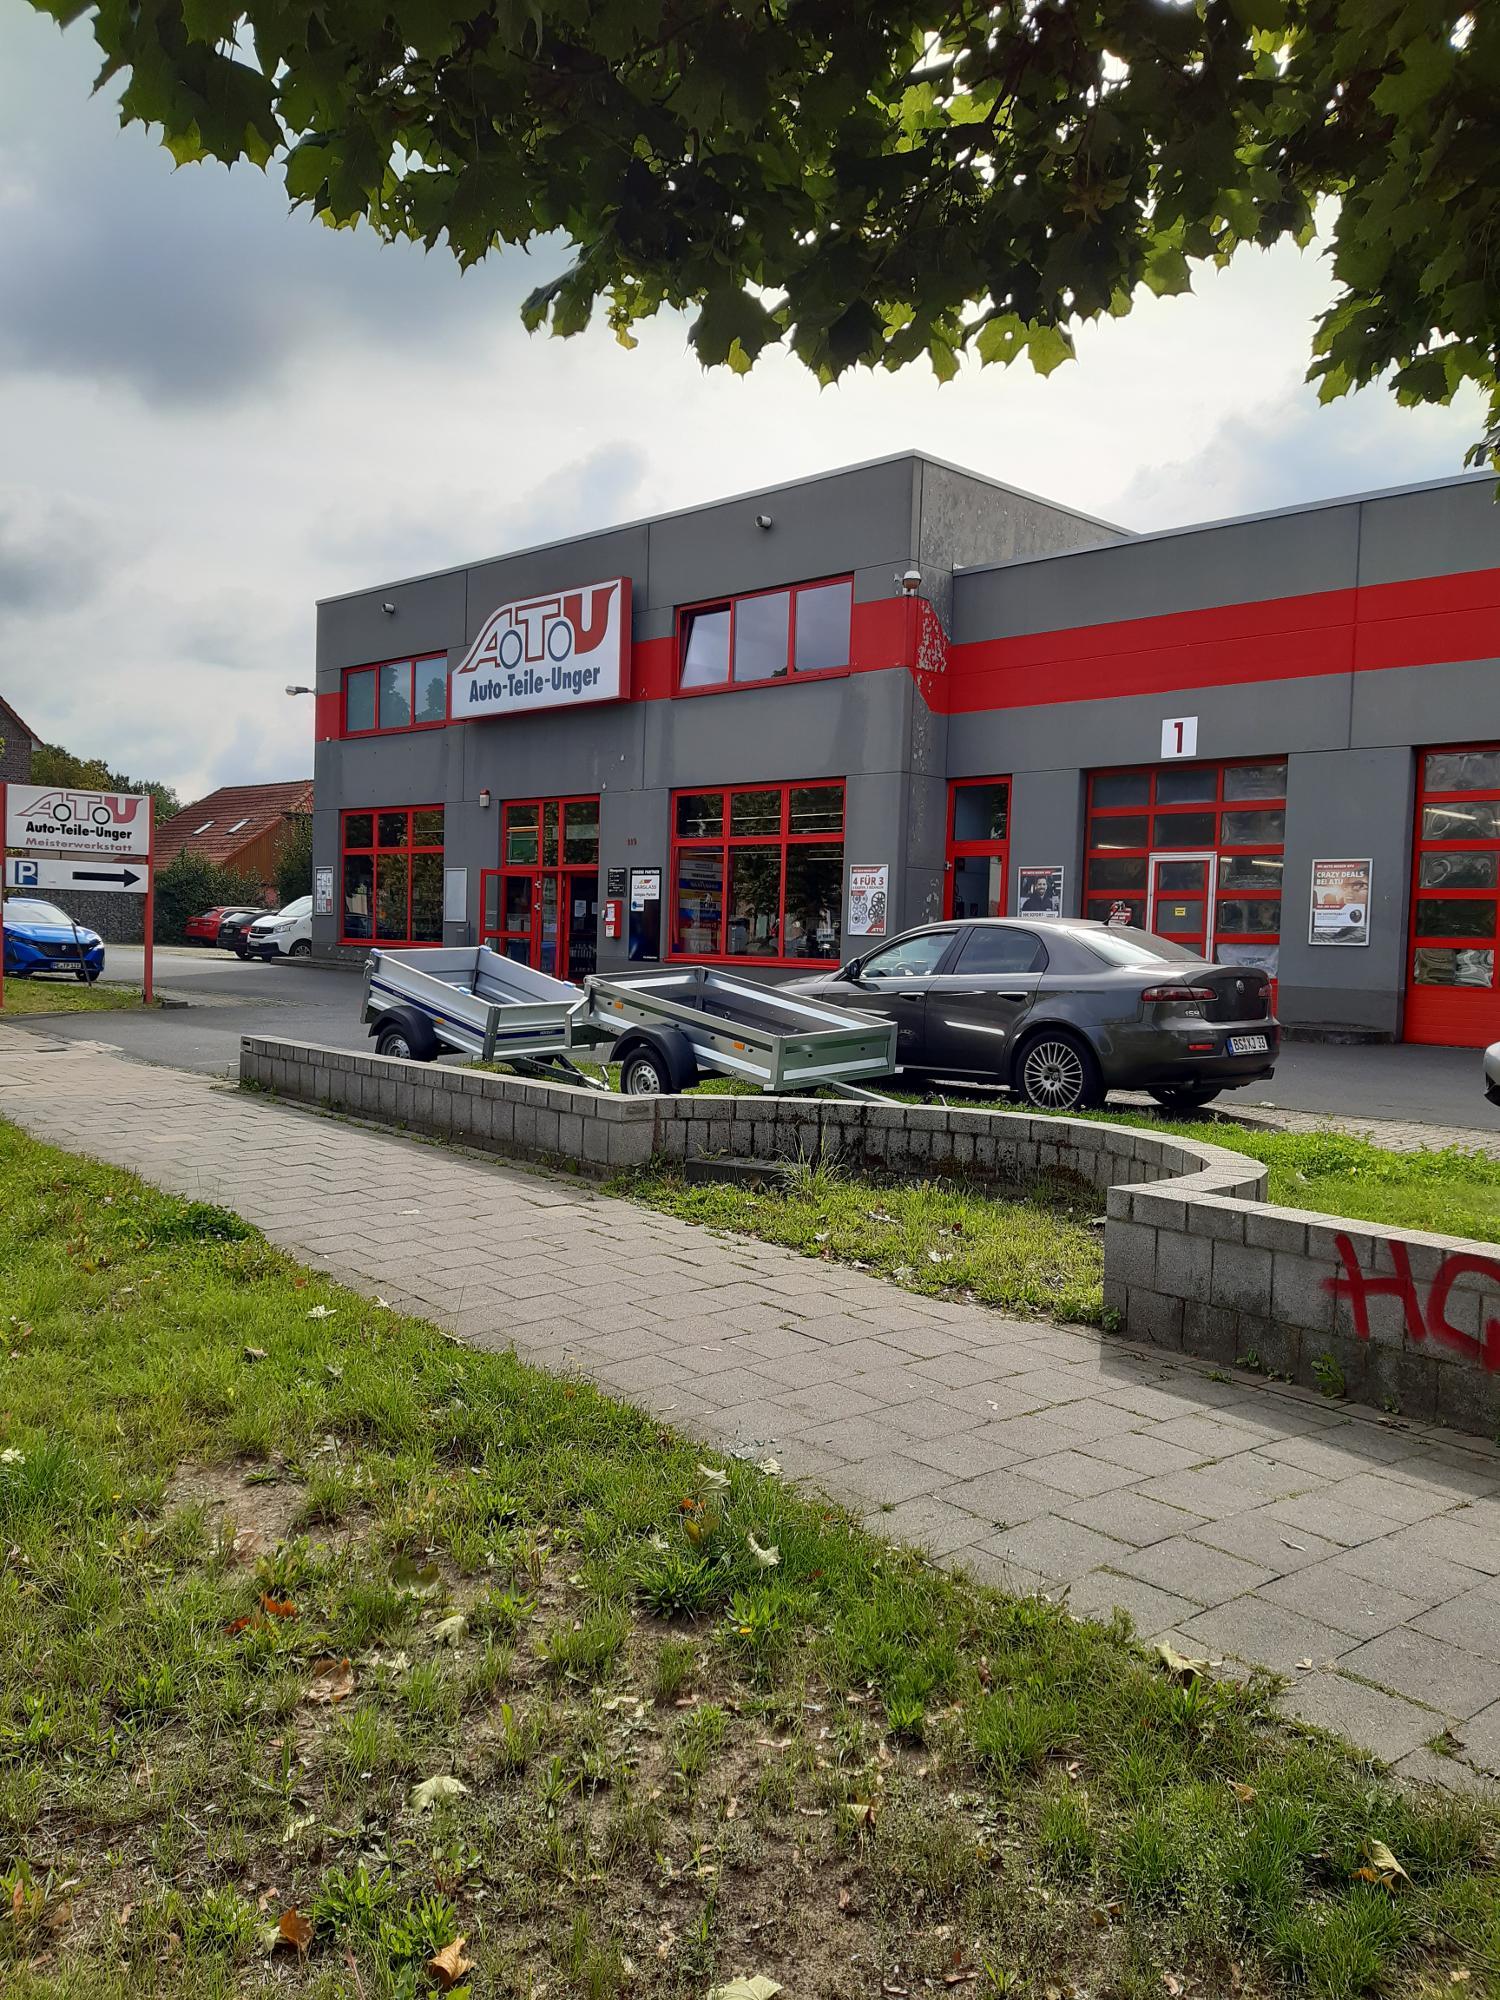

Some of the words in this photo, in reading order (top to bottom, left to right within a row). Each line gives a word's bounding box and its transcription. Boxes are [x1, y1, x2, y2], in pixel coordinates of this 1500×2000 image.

[469, 666, 600, 702] Auto-Teile-Unger
[1174, 721, 1183, 754] 1
[26, 821, 132, 841] Auto-Teile-Unger
[25, 837, 132, 852] Meisterwerkstatt
[19, 862, 36, 884] P
[853, 877, 858, 885] 4
[860, 874, 877, 886] FÜR
[879, 877, 884, 886] 3
[1233, 1038, 1244, 1051] BS
[1257, 1036, 1266, 1049] 33
